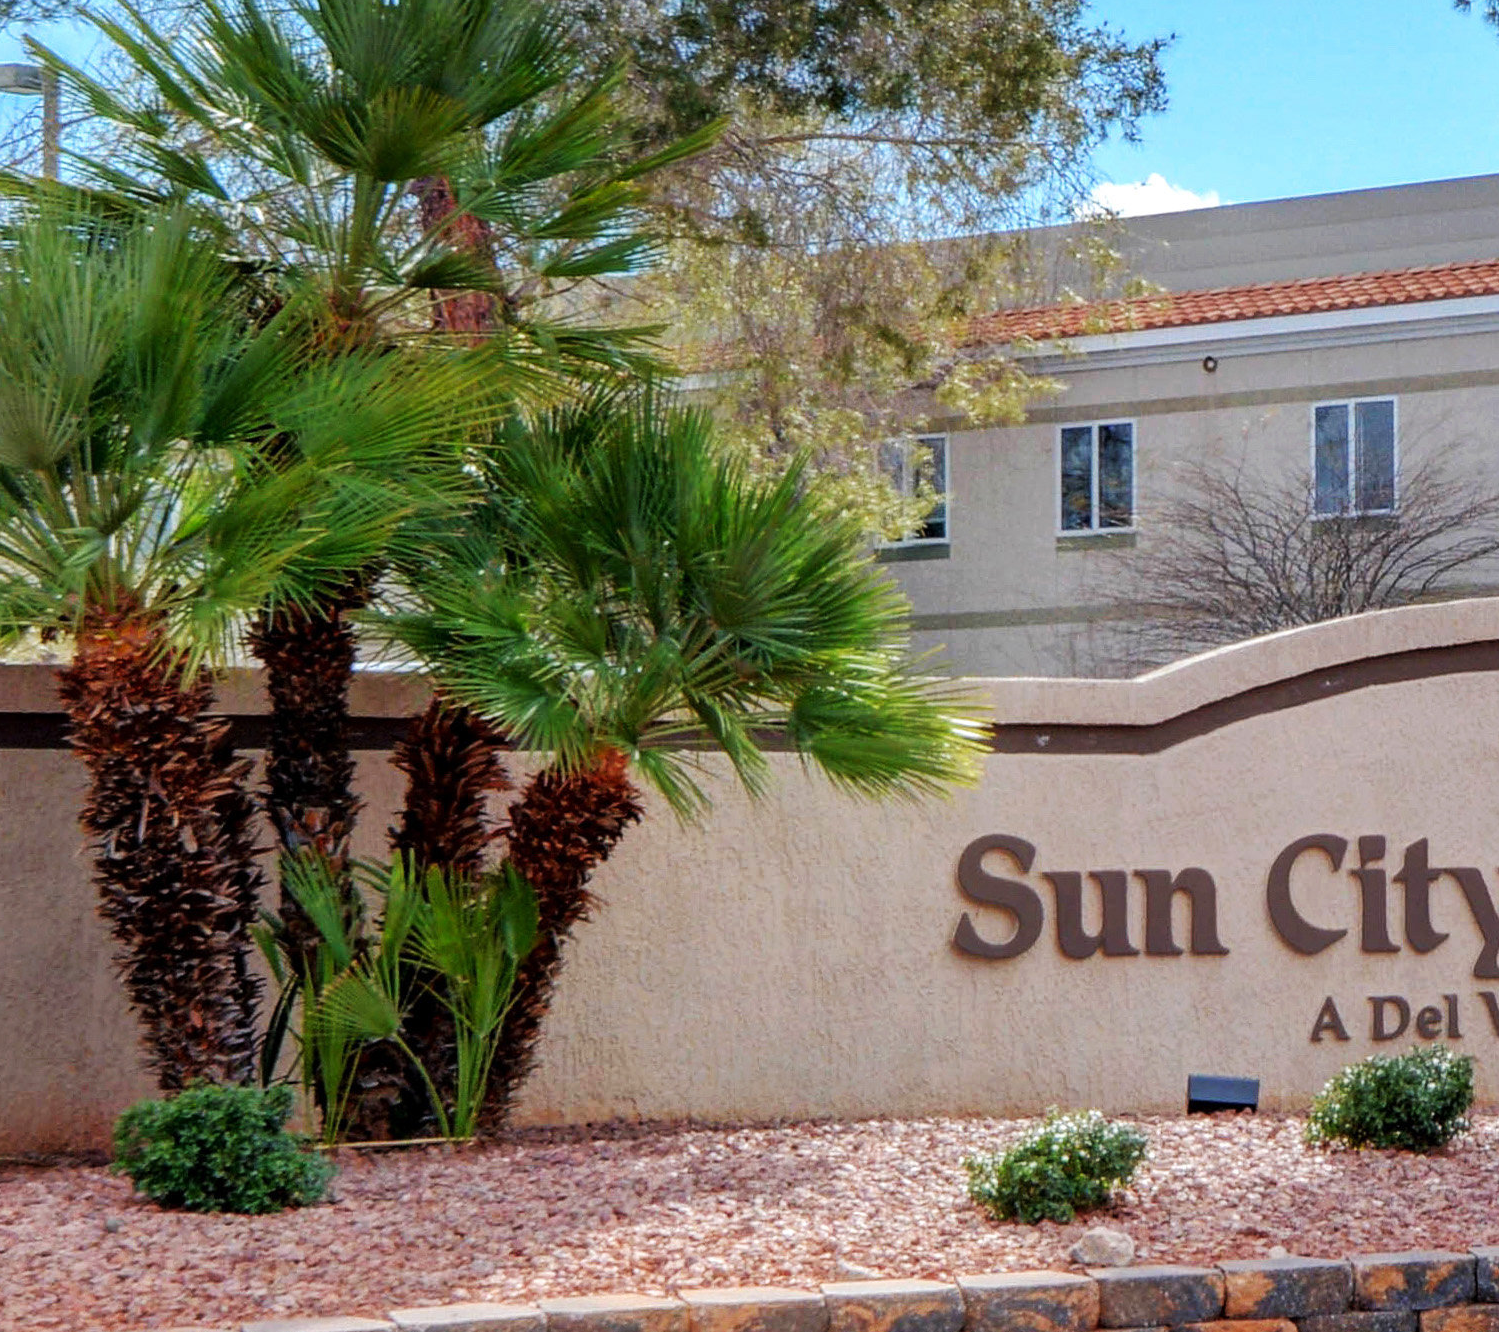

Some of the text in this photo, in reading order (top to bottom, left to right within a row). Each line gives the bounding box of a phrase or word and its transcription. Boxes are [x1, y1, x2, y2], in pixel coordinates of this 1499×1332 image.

[951, 832, 1230, 960] Sun
[1310, 994, 1352, 1043] A
[1368, 993, 1461, 1041] Del
